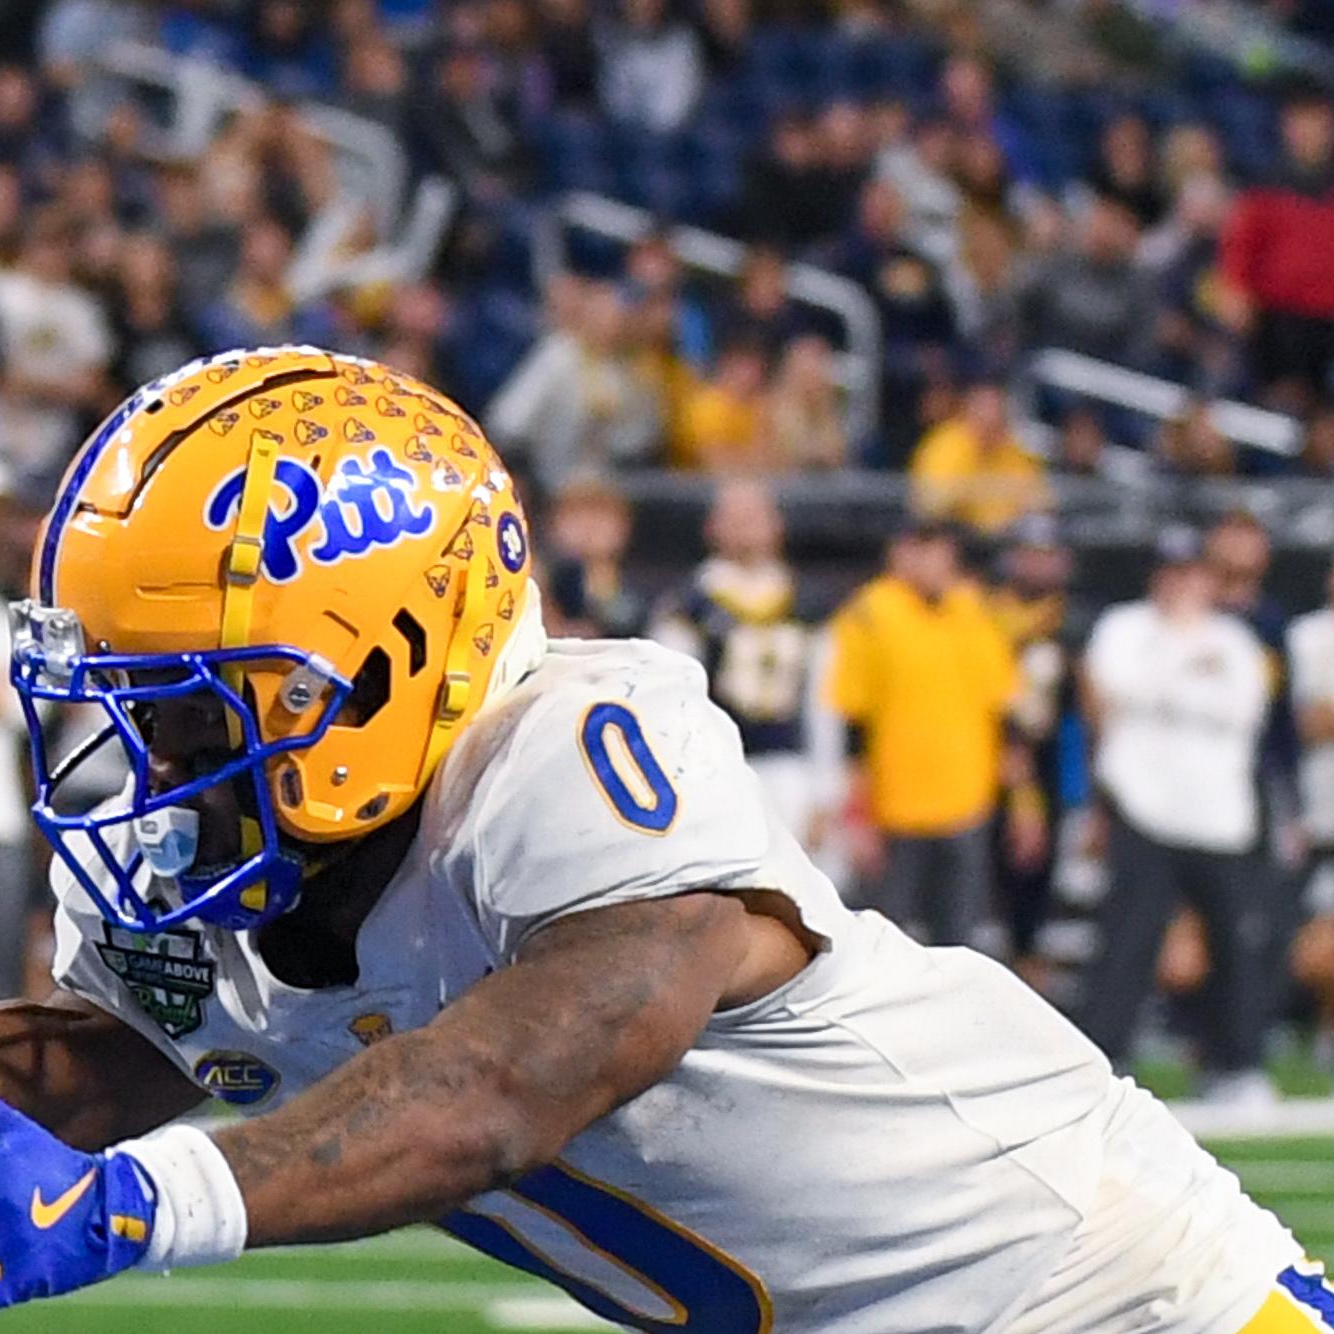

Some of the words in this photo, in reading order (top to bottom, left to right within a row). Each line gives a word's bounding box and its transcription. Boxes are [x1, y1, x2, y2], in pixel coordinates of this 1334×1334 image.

[205, 448, 434, 583] Pitt
[576, 700, 681, 837] 0
[203, 1065, 264, 1088] ACC
